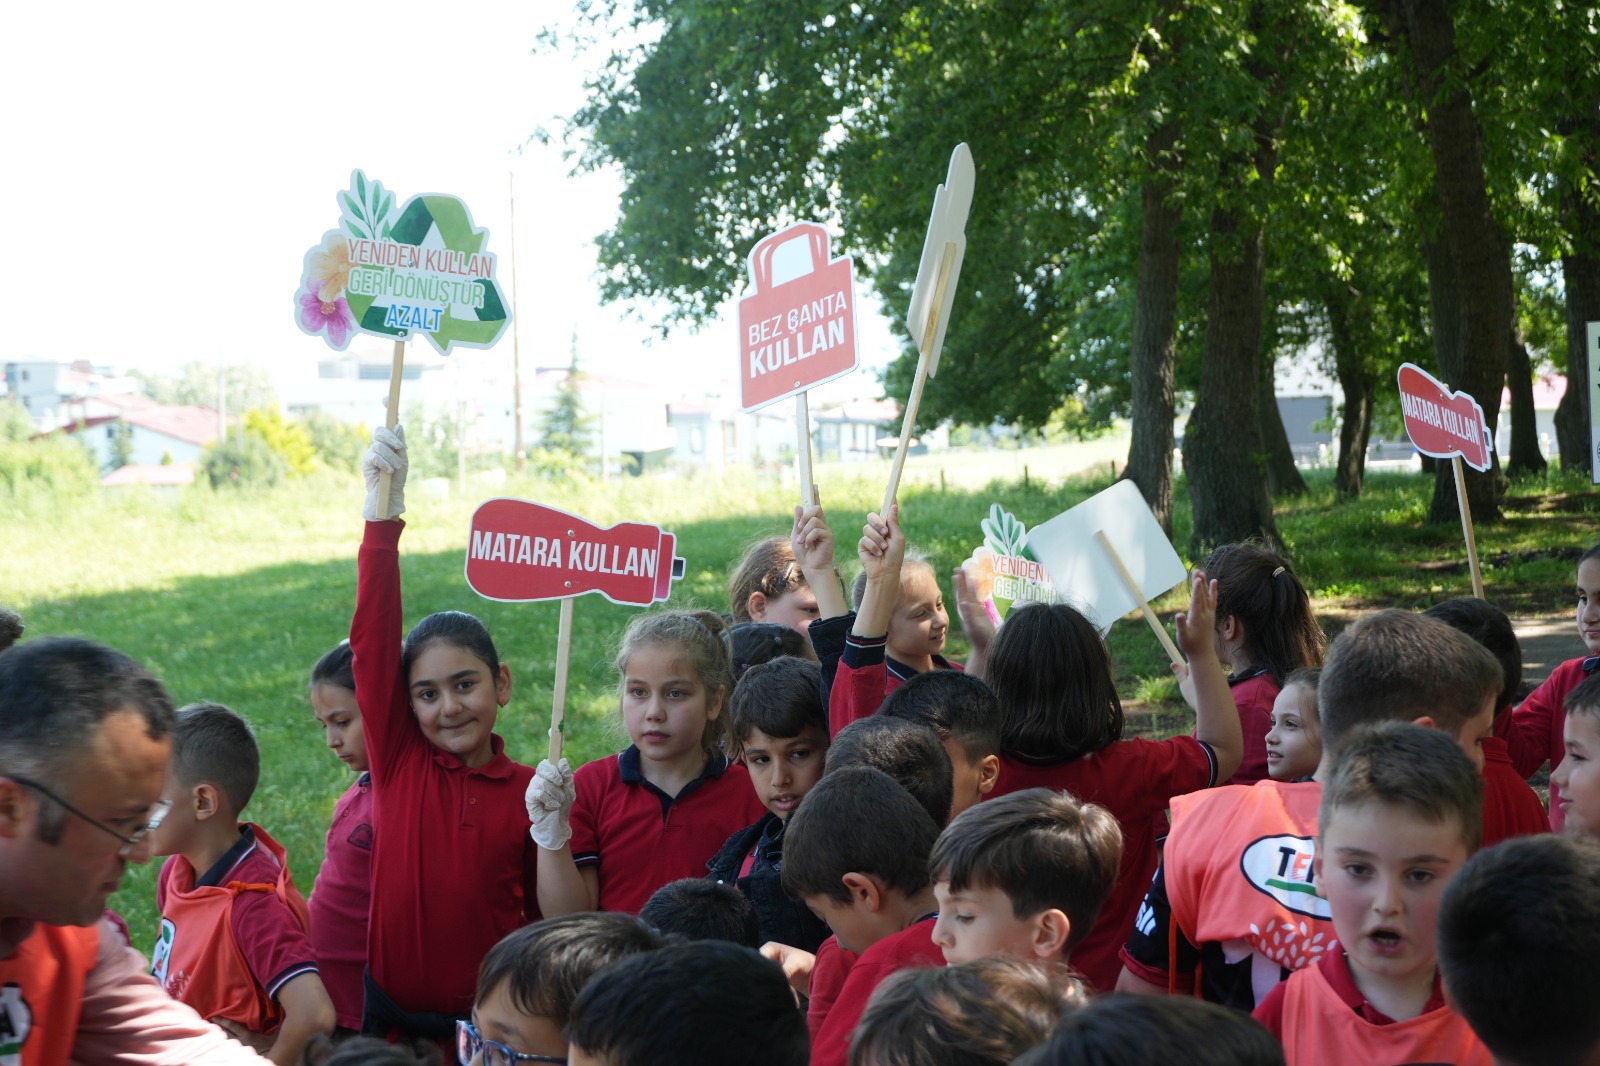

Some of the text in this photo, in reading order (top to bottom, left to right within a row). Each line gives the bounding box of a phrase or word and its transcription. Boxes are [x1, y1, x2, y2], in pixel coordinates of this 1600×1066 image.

[348, 238, 493, 278] YENİDEN KULLAN
[349, 269, 485, 307] GERİ DÖNÜŞTÜR
[386, 303, 443, 331] AZALT
[748, 290, 848, 347] BEZ ÇANTA
[749, 316, 845, 379] KULLAN
[1401, 391, 1480, 446] MATARA KULLAN
[471, 530, 656, 578] MATARA KULLAN
[992, 554, 1045, 582] YENİDEN
[995, 578, 1022, 600] GERİ
